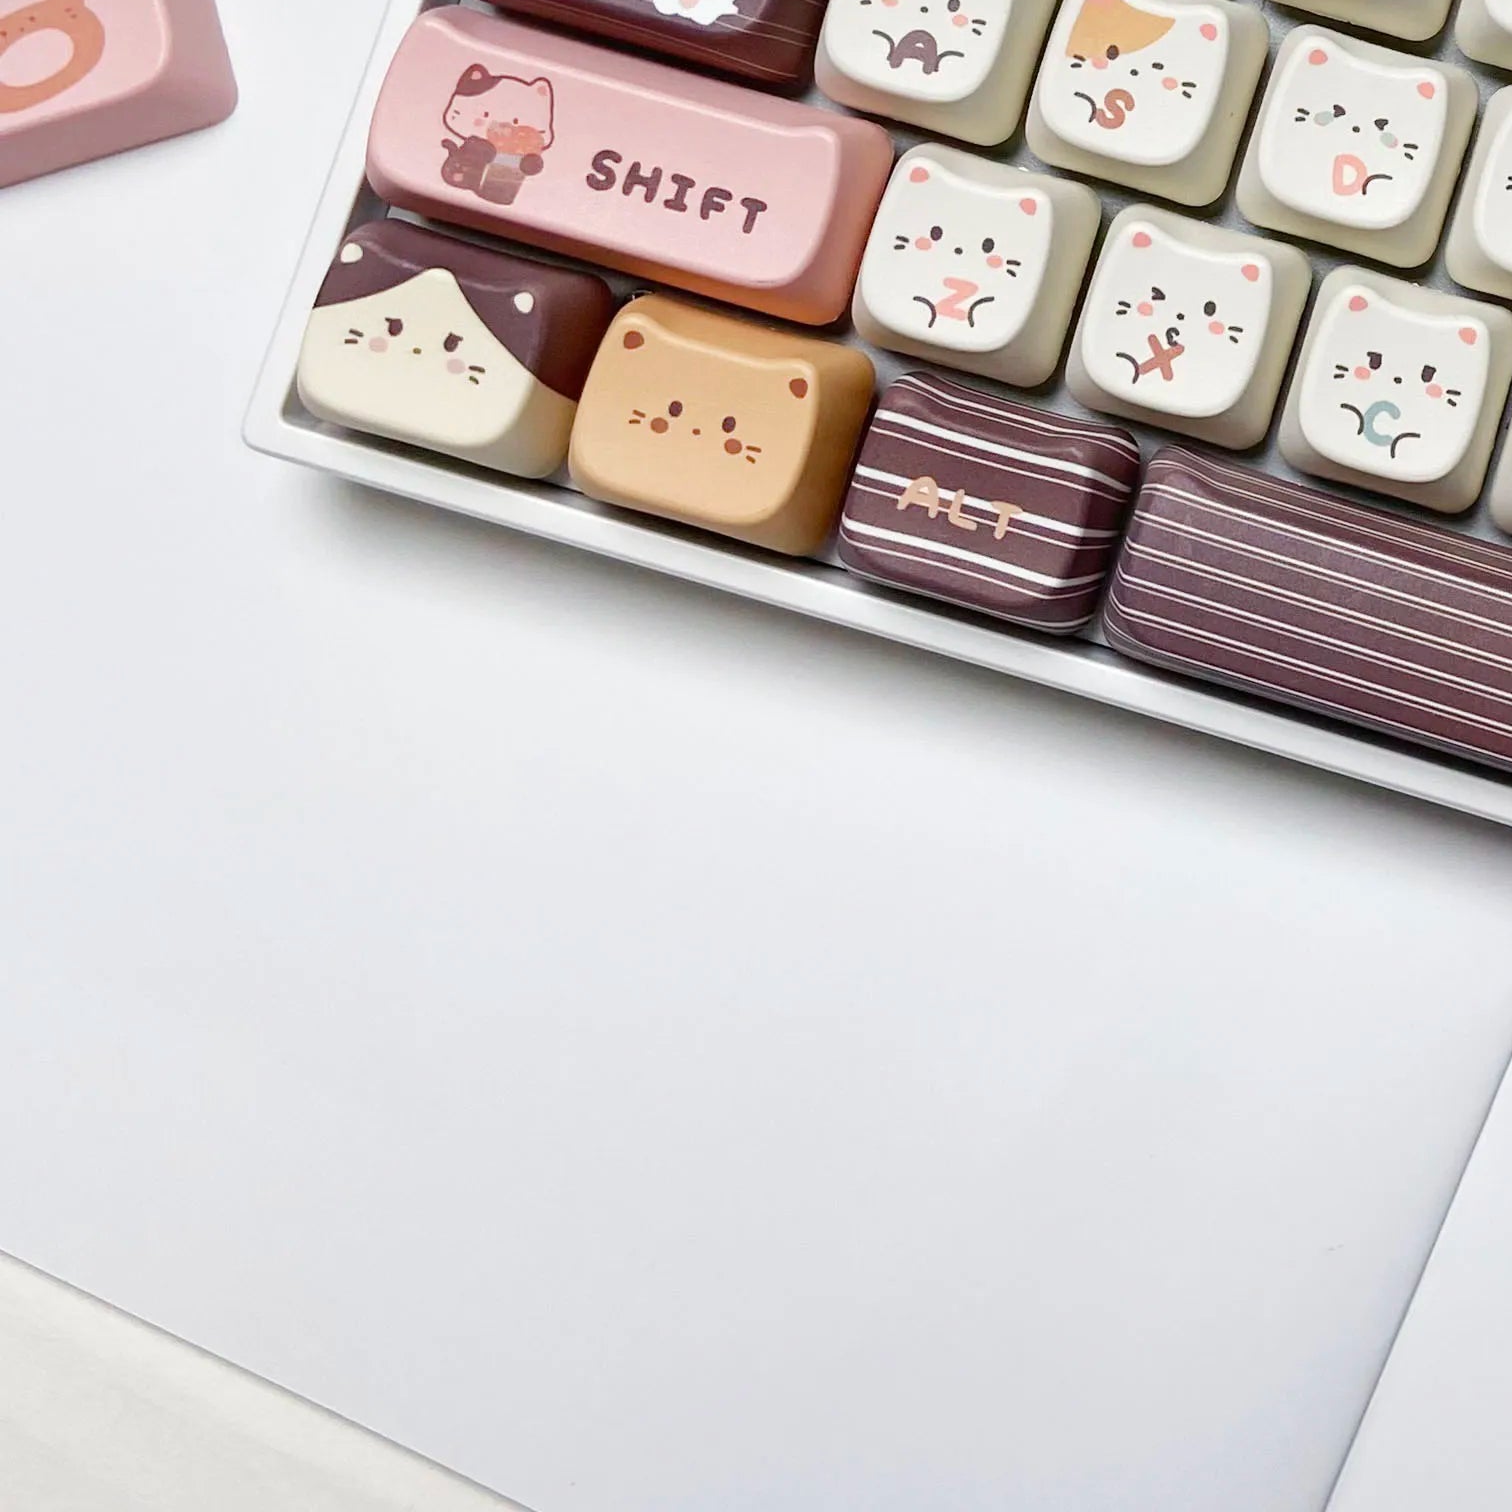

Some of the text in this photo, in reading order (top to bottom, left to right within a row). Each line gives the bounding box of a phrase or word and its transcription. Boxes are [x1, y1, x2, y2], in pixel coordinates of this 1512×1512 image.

[889, 30, 938, 75] A
[1096, 88, 1135, 129] S
[585, 149, 767, 234] SHIFT
[1333, 153, 1367, 196] D
[934, 277, 980, 321] Z
[1138, 334, 1185, 381] X
[1363, 400, 1401, 446] C
[896, 476, 1024, 540] ALT
